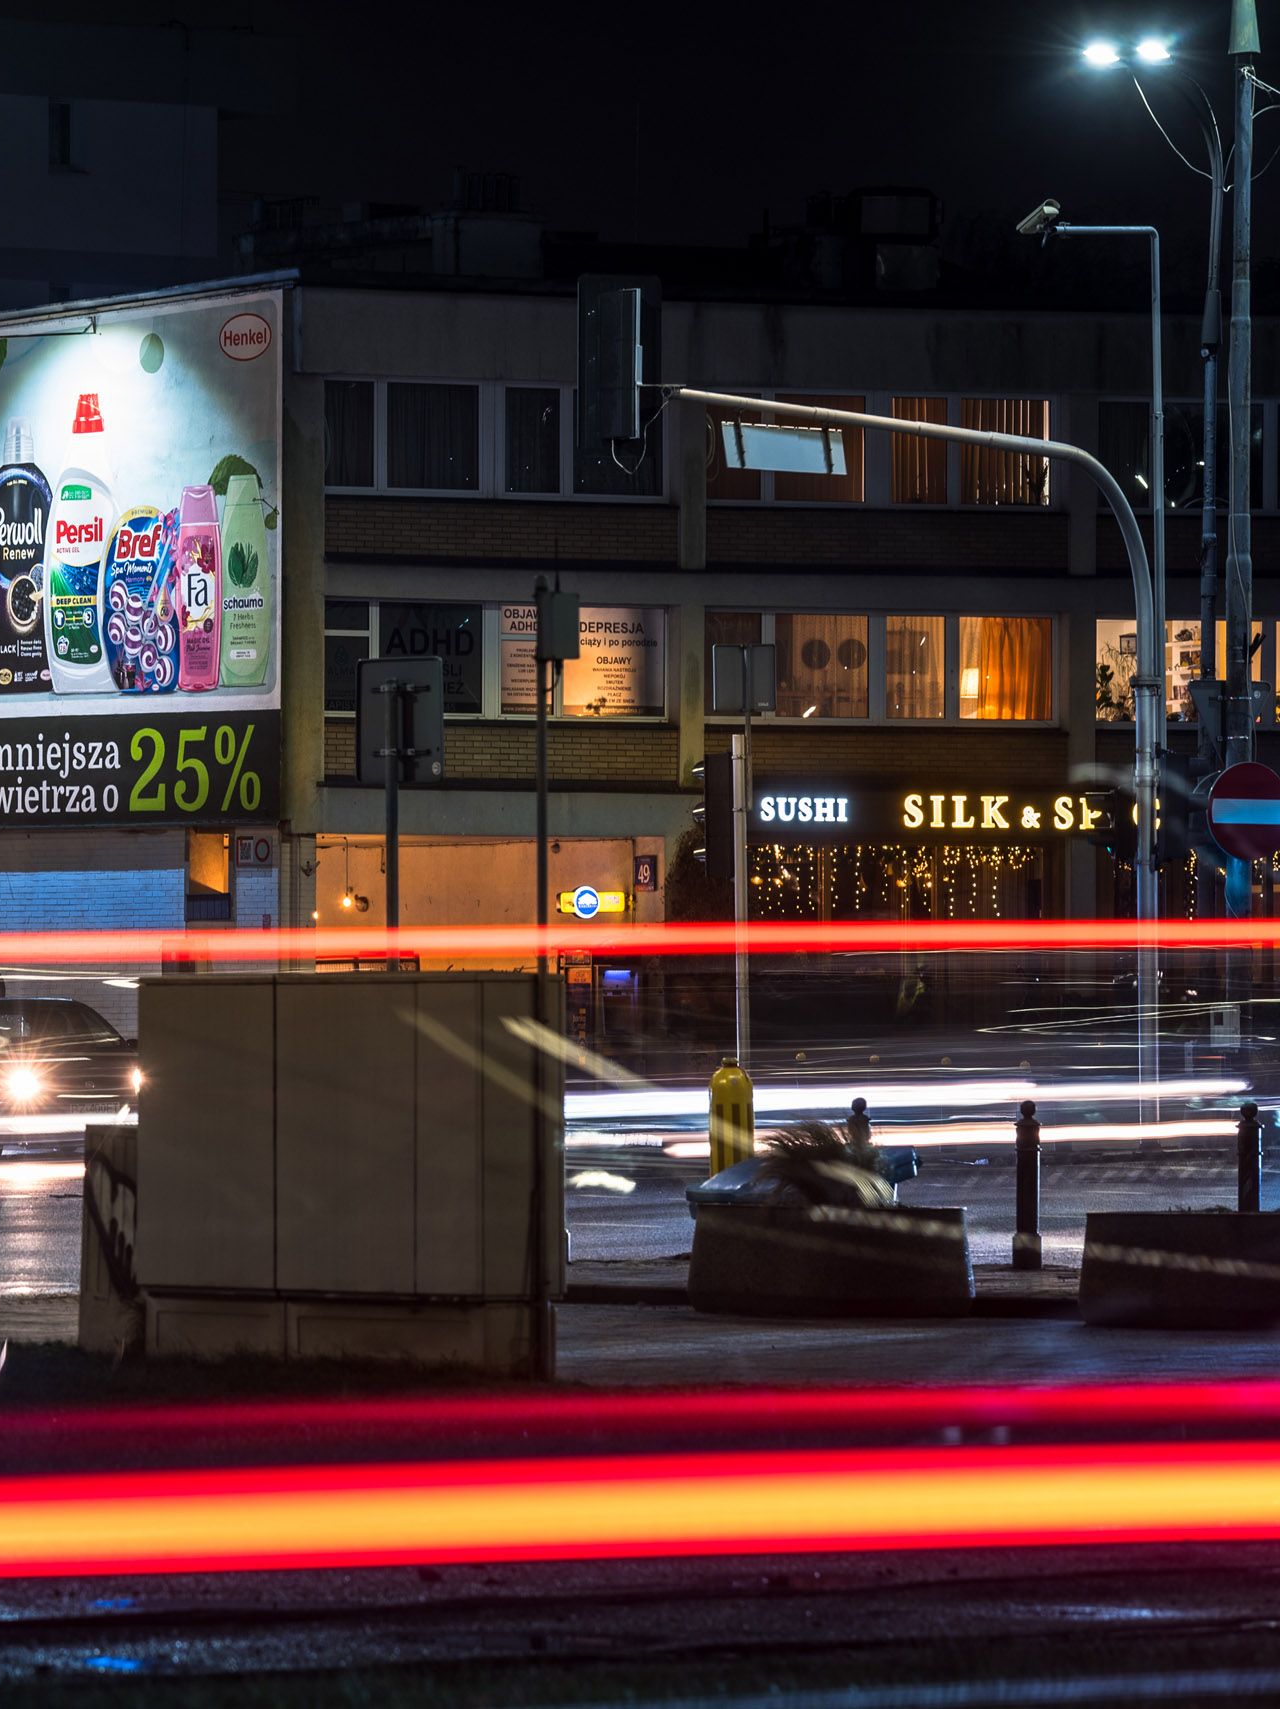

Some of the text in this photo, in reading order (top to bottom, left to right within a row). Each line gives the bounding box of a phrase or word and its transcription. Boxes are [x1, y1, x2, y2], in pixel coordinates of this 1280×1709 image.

[223, 327, 267, 347] Henkel
[56, 516, 103, 544] Persil
[2, 546, 35, 560] Renew
[116, 524, 162, 560] Bref
[72, 597, 92, 605] CLEAN
[187, 573, 209, 608] Fa
[223, 597, 264, 610] schauma
[580, 621, 644, 634] DEPRESJA
[385, 627, 474, 656] ADHD
[580, 637, 602, 648] ciąży
[608, 639, 620, 648] po
[621, 637, 658, 648] porodzie
[596, 656, 632, 665] OBJAWY
[129, 724, 261, 812] 25%
[102, 784, 119, 813] o
[760, 796, 848, 823] SUSHI
[903, 794, 1010, 829] SILK
[1021, 805, 1041, 829] &
[637, 864, 651, 883] 49
